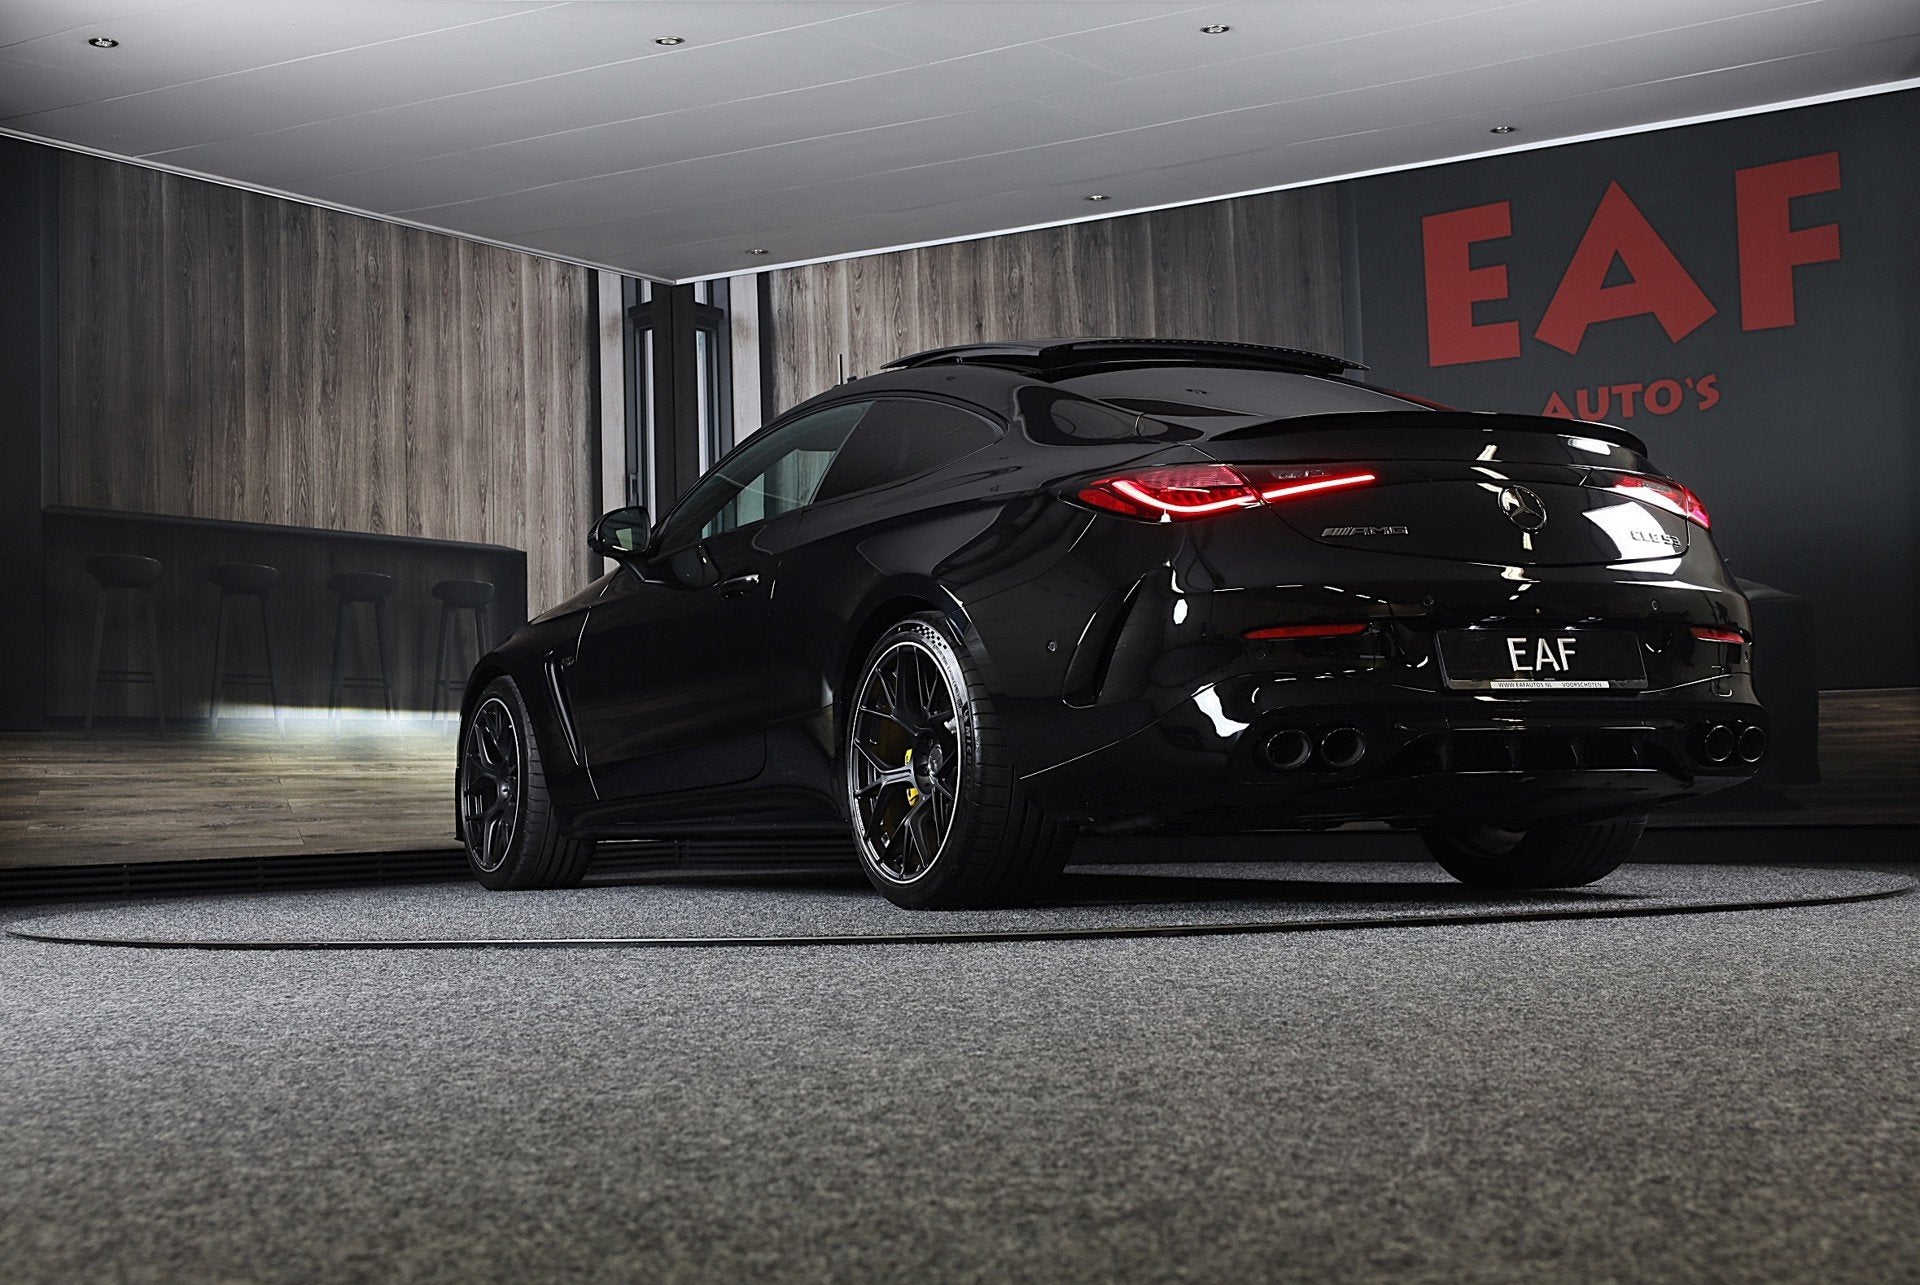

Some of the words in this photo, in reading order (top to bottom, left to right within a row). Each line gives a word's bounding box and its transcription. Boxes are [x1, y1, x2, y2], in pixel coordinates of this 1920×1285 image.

[1422, 151, 1841, 367] EAF
[1541, 373, 1721, 421] AUTO'S
[1630, 529, 1660, 543] CLE
[1660, 533, 1682, 547] 53
[1506, 637, 1577, 672] EAF
